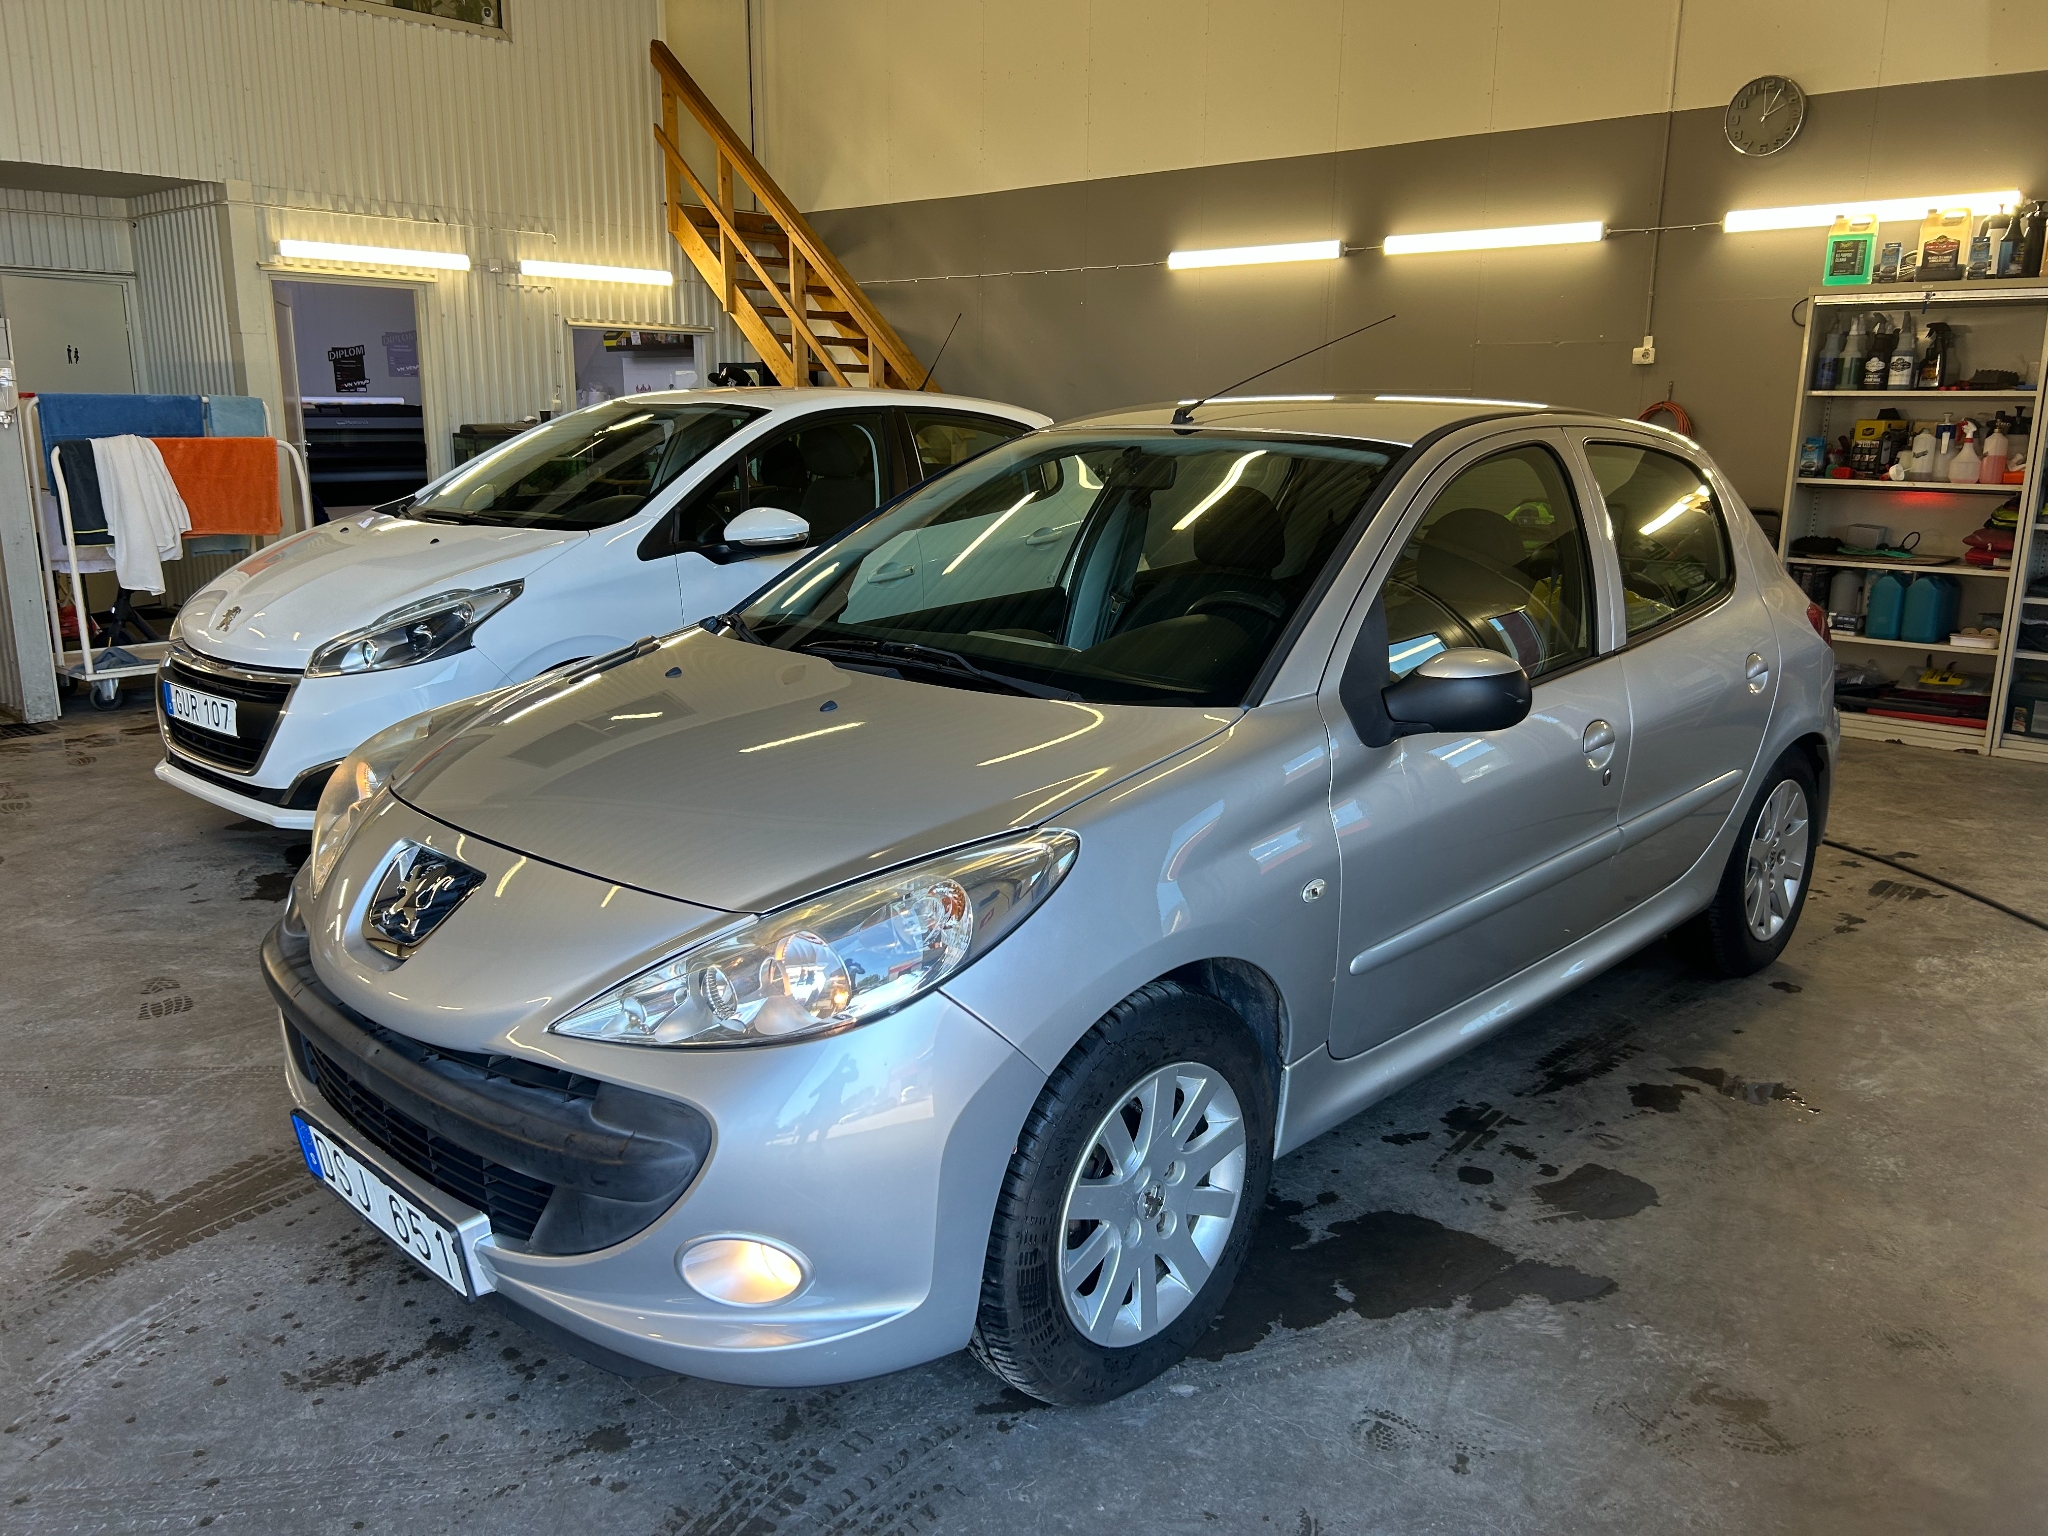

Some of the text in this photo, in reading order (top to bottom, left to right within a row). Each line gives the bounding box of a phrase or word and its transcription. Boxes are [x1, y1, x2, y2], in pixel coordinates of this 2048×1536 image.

[1747, 84, 1757, 95] 11
[1761, 79, 1776, 90] 12
[1736, 98, 1748, 109] 10
[1788, 93, 1799, 104] 2
[1731, 115, 1740, 125] 9
[1784, 124, 1794, 135] 4
[1734, 130, 1743, 141] 8
[329, 346, 364, 360] DIPLOM
[175, 689, 229, 730] GUR 107
[314, 1132, 455, 1281] DSJ 651
